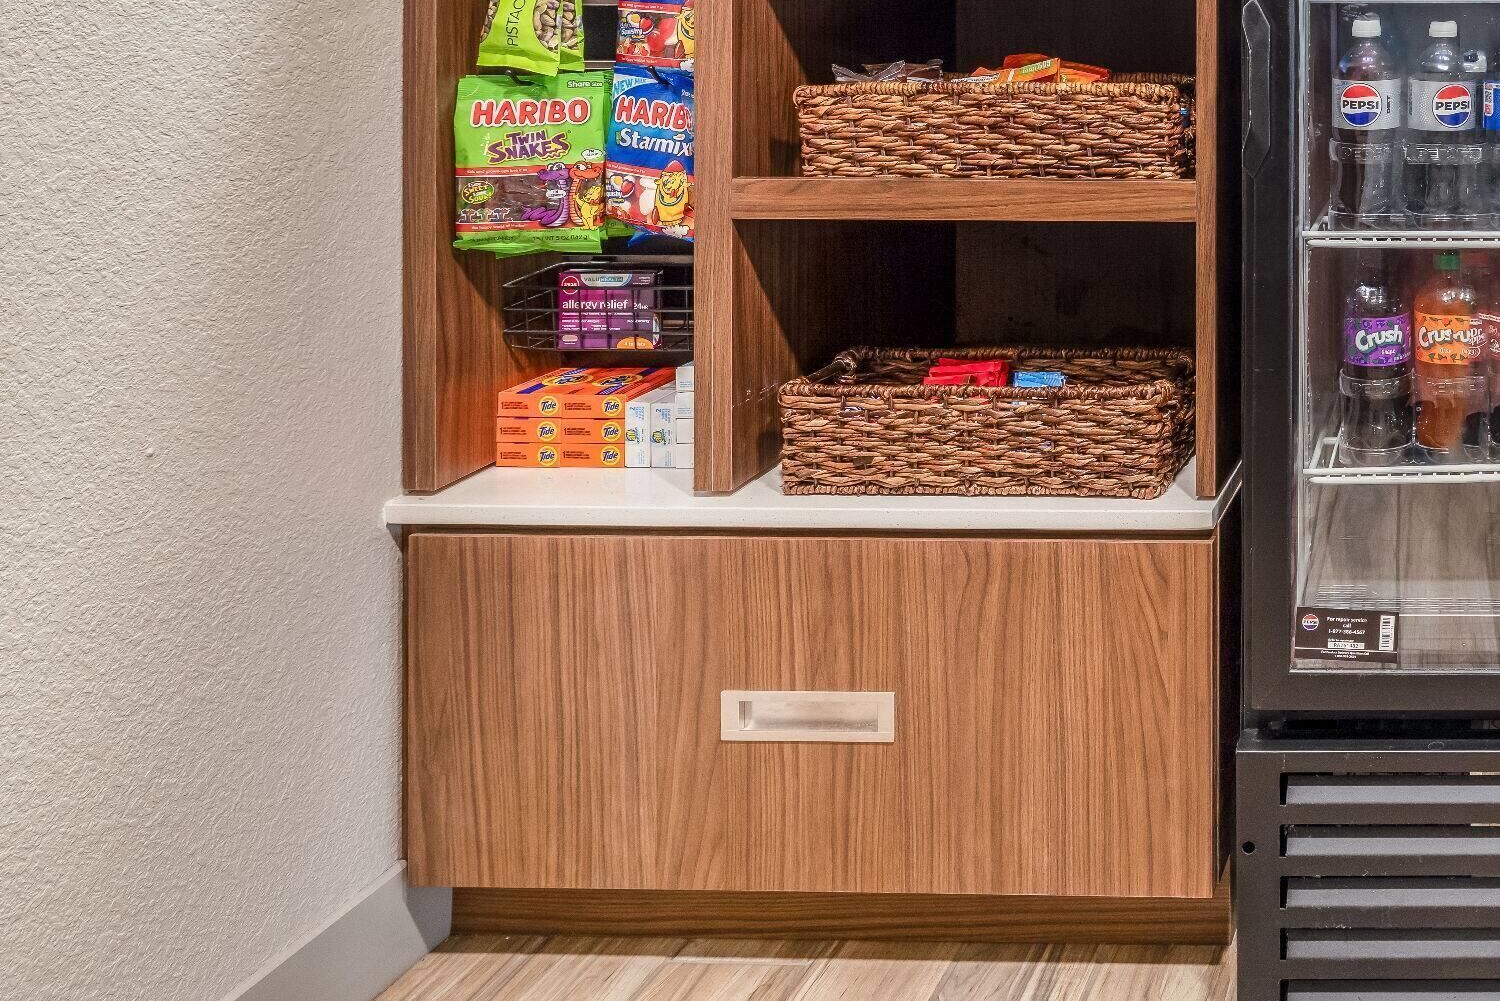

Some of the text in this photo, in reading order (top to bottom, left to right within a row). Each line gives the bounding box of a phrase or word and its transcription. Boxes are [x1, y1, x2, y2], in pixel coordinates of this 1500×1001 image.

[567, 80, 590, 88] Share
[1342, 100, 1378, 110] PEPSI
[1435, 100, 1470, 110] PEPSI
[471, 98, 590, 126] HARIBO
[505, 130, 547, 146] TWIN
[487, 132, 571, 164] SNAKES
[562, 299, 598, 310] allergy
[1355, 325, 1403, 351] Crush
[540, 400, 557, 412] Tide
[604, 400, 620, 412] Tide
[538, 425, 555, 437] Tide
[603, 425, 619, 437] Tide
[539, 449, 555, 461] Tide
[602, 449, 619, 460] Tide
